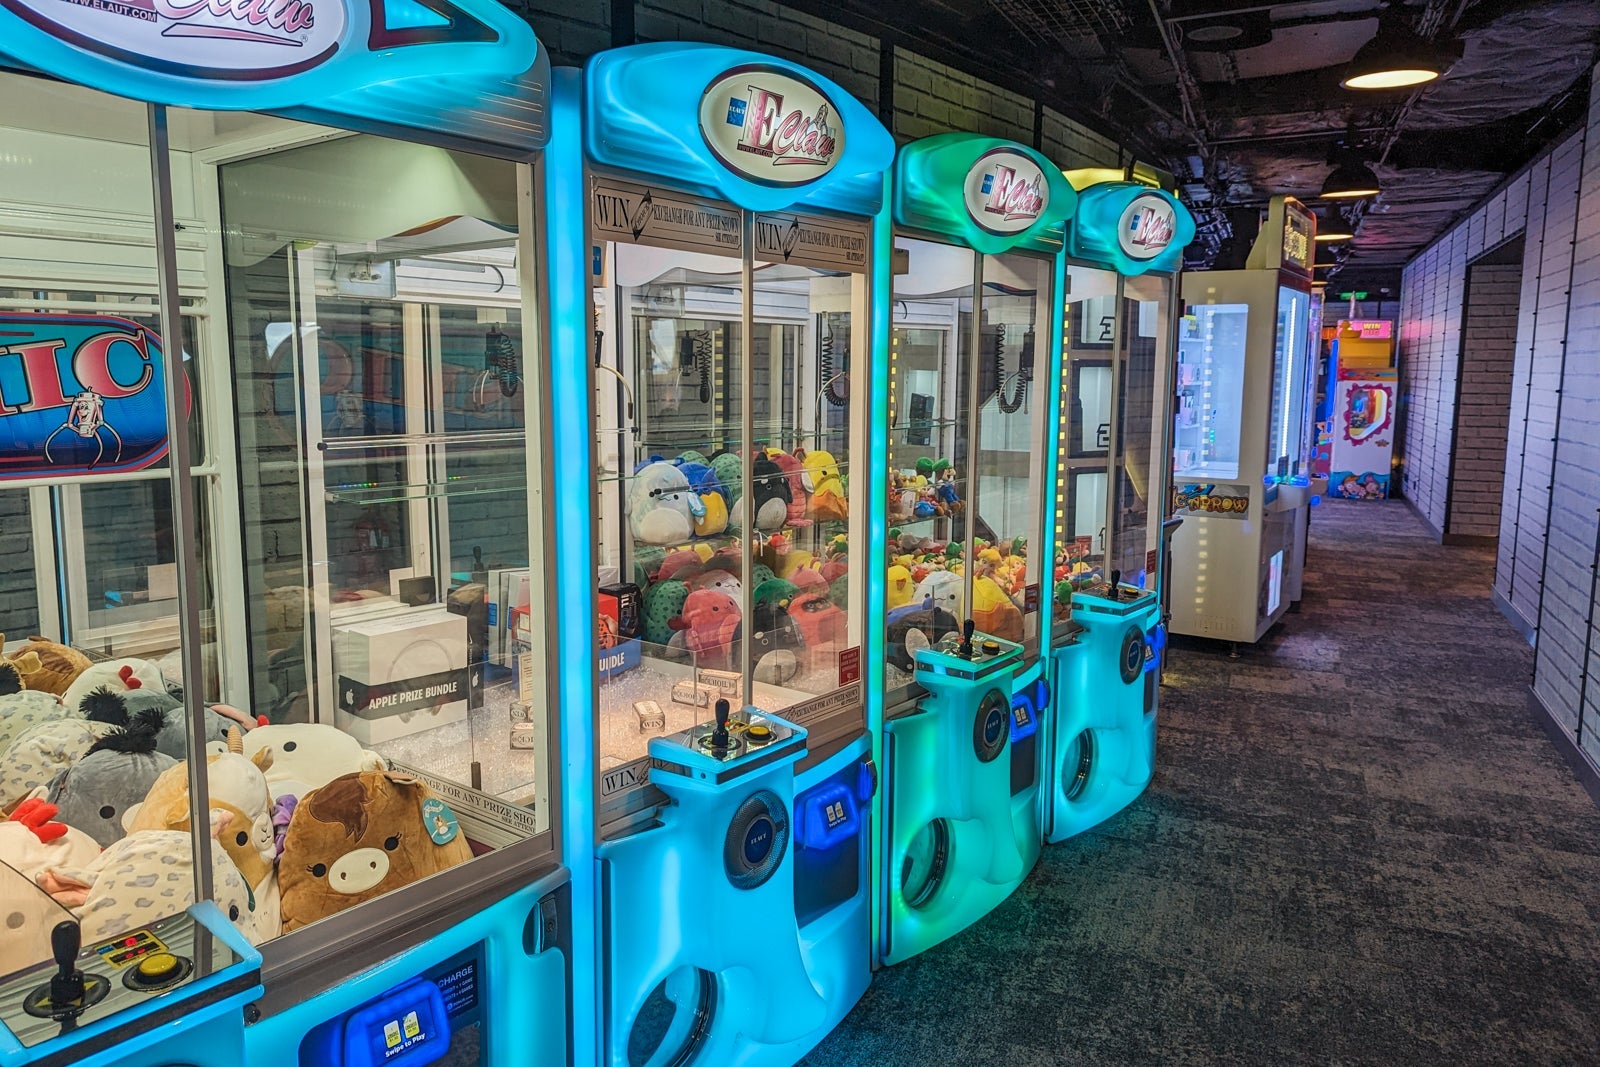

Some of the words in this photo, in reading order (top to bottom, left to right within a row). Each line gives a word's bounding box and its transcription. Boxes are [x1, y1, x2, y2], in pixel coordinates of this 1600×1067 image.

[62, 0, 157, 23] WW.ELAUT.COM
[596, 194, 630, 229] WIN
[683, 209, 695, 226] FOR
[695, 211, 706, 228] ANY
[757, 222, 783, 251] WIN
[0, 329, 154, 417] IC
[368, 696, 397, 710] APPLE
[400, 689, 423, 703] PRIZE
[425, 681, 457, 698] BUNDLE
[644, 720, 662, 728] WIN
[604, 766, 637, 792] WIN
[442, 783, 461, 799] FOR
[462, 793, 482, 807] ANY
[483, 799, 512, 818] PRIZE
[513, 811, 535, 826] SHO
[501, 815, 513, 825] SEE
[513, 821, 535, 833] ATTEN
[385, 1044, 405, 1058] Swipe
[405, 1040, 412, 1048] to
[412, 1032, 426, 1044] Play
